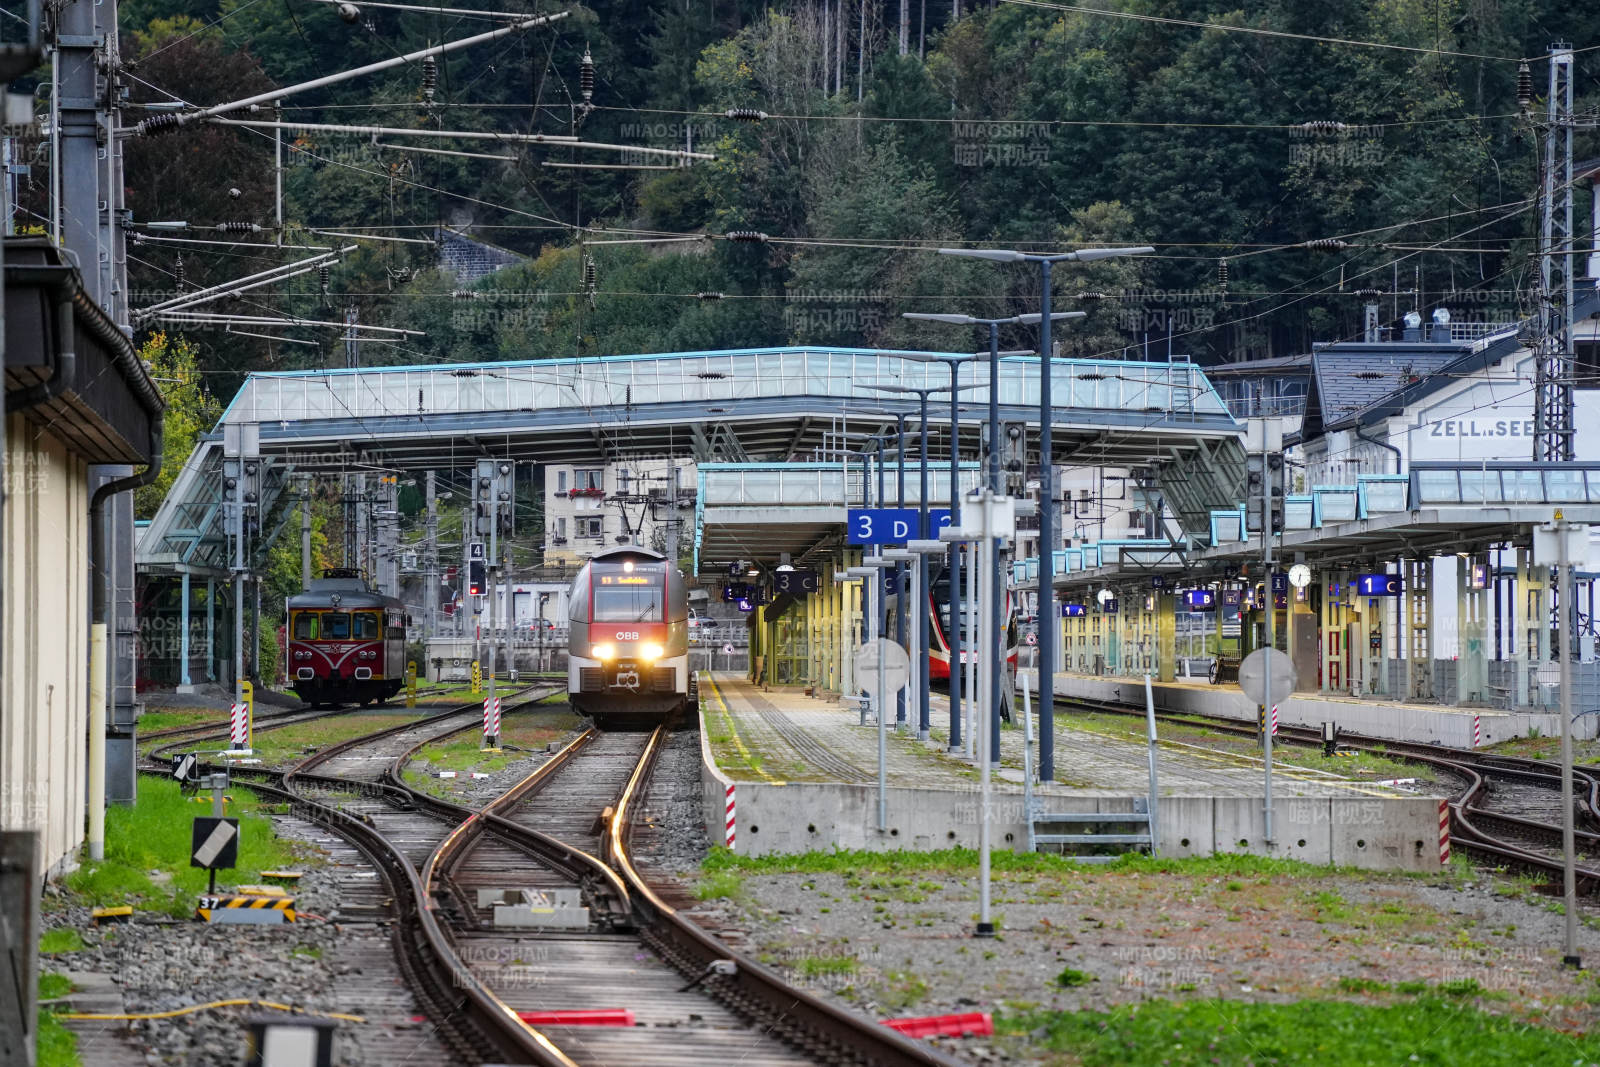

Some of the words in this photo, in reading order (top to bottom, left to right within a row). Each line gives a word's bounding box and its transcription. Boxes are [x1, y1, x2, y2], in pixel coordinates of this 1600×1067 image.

[1430, 421, 1480, 437] ZELL
[1495, 421, 1535, 437] SEE
[857, 514, 873, 539] 3
[893, 520, 908, 539] D
[474, 545, 482, 557] 4
[780, 574, 790, 590] 3
[802, 577, 812, 589] C
[1364, 577, 1372, 593] 1
[1386, 581, 1396, 593] C
[1187, 592, 1193, 604] 1
[1203, 594, 1211, 604] B
[1065, 606, 1070, 616] 1
[1077, 608, 1084, 616] A
[200, 897, 219, 909] 37
